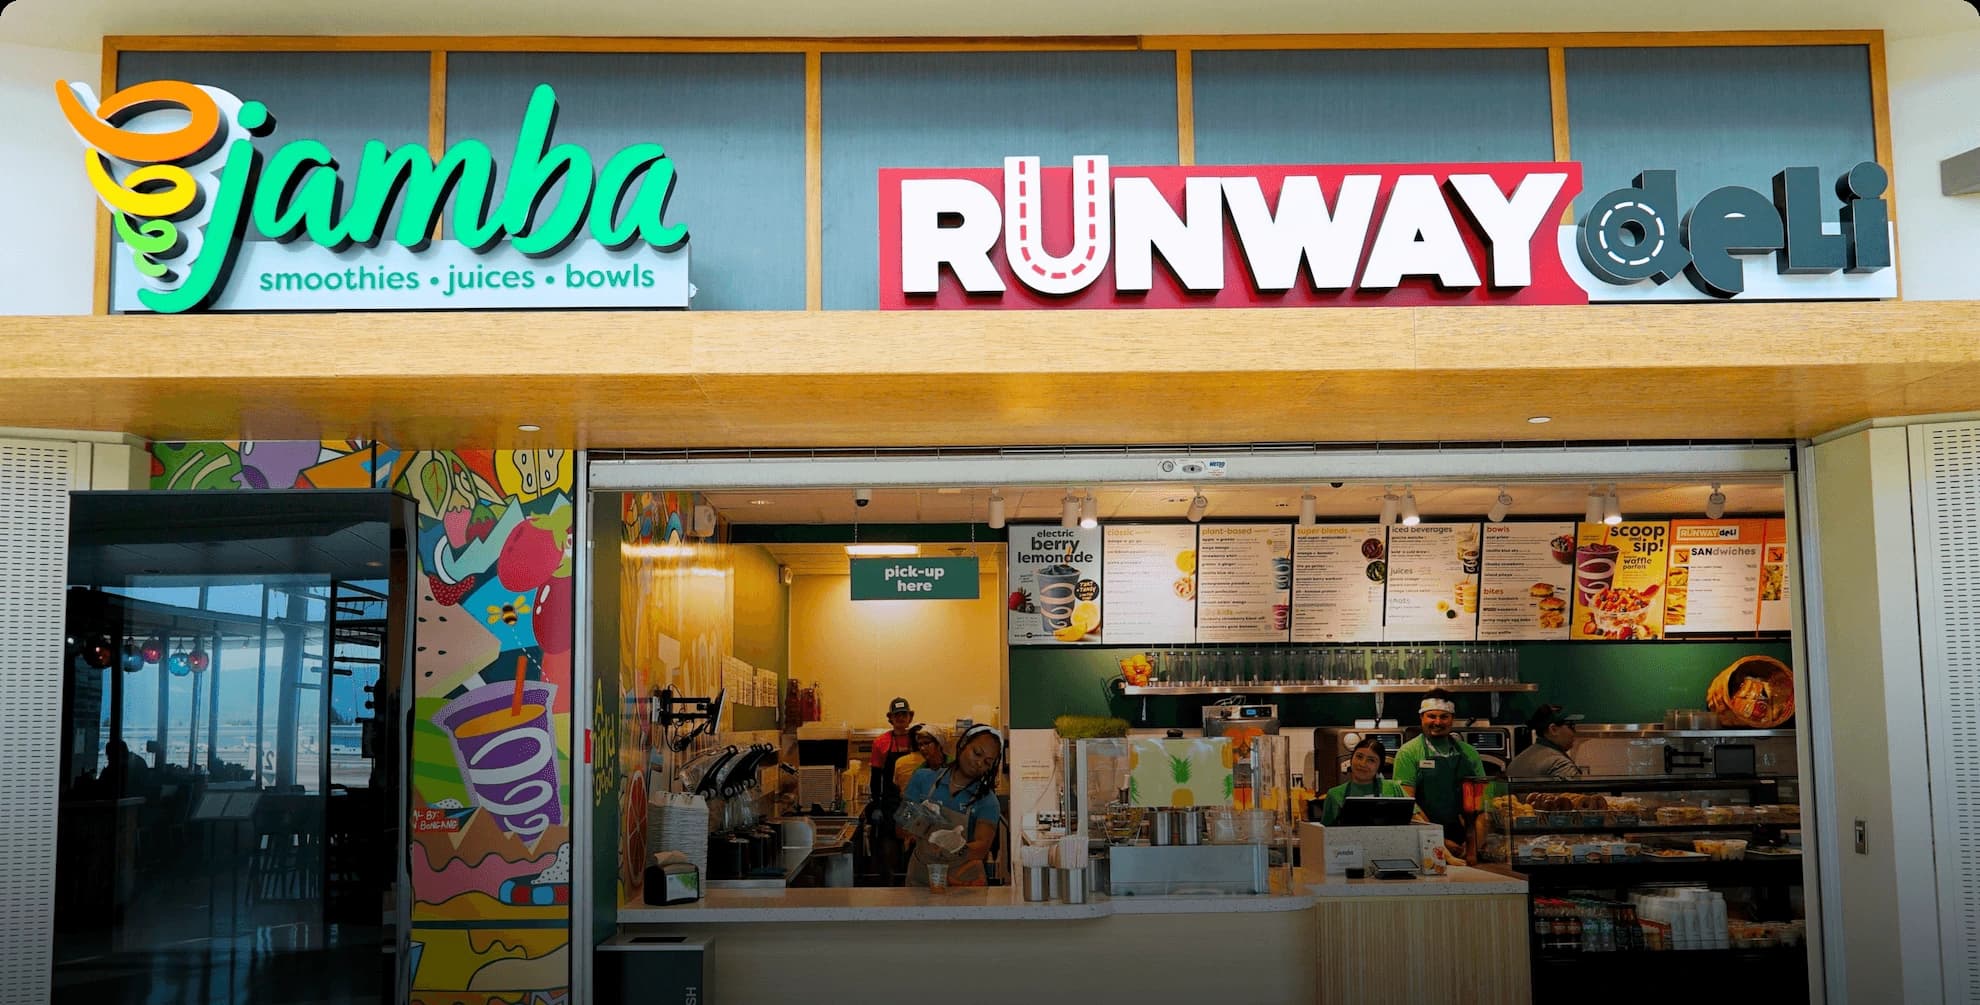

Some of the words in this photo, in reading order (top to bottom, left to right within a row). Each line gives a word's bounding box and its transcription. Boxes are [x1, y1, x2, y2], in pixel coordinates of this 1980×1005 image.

[137, 83, 688, 313] jamba
[900, 154, 1568, 295] RUNWAY
[260, 265, 420, 291] smoothies
[442, 264, 535, 296] juices
[566, 263, 655, 288] bowls
[1037, 529, 1074, 537] electric
[1202, 527, 1252, 535] plant-based
[1411, 526, 1453, 534] beverages
[1486, 525, 1510, 533] bowls
[1610, 526, 1665, 540] scoop
[1680, 529, 1718, 537] RUNWAY
[1031, 537, 1080, 553] berry
[1633, 538, 1664, 556] sip!
[1691, 547, 1756, 556] SANdwiches
[1018, 551, 1094, 563] lemonade
[1623, 556, 1652, 564] waffle
[884, 565, 945, 581] pick-up
[1390, 567, 1413, 576] juices
[897, 580, 933, 592] here
[1483, 587, 1504, 595] bites
